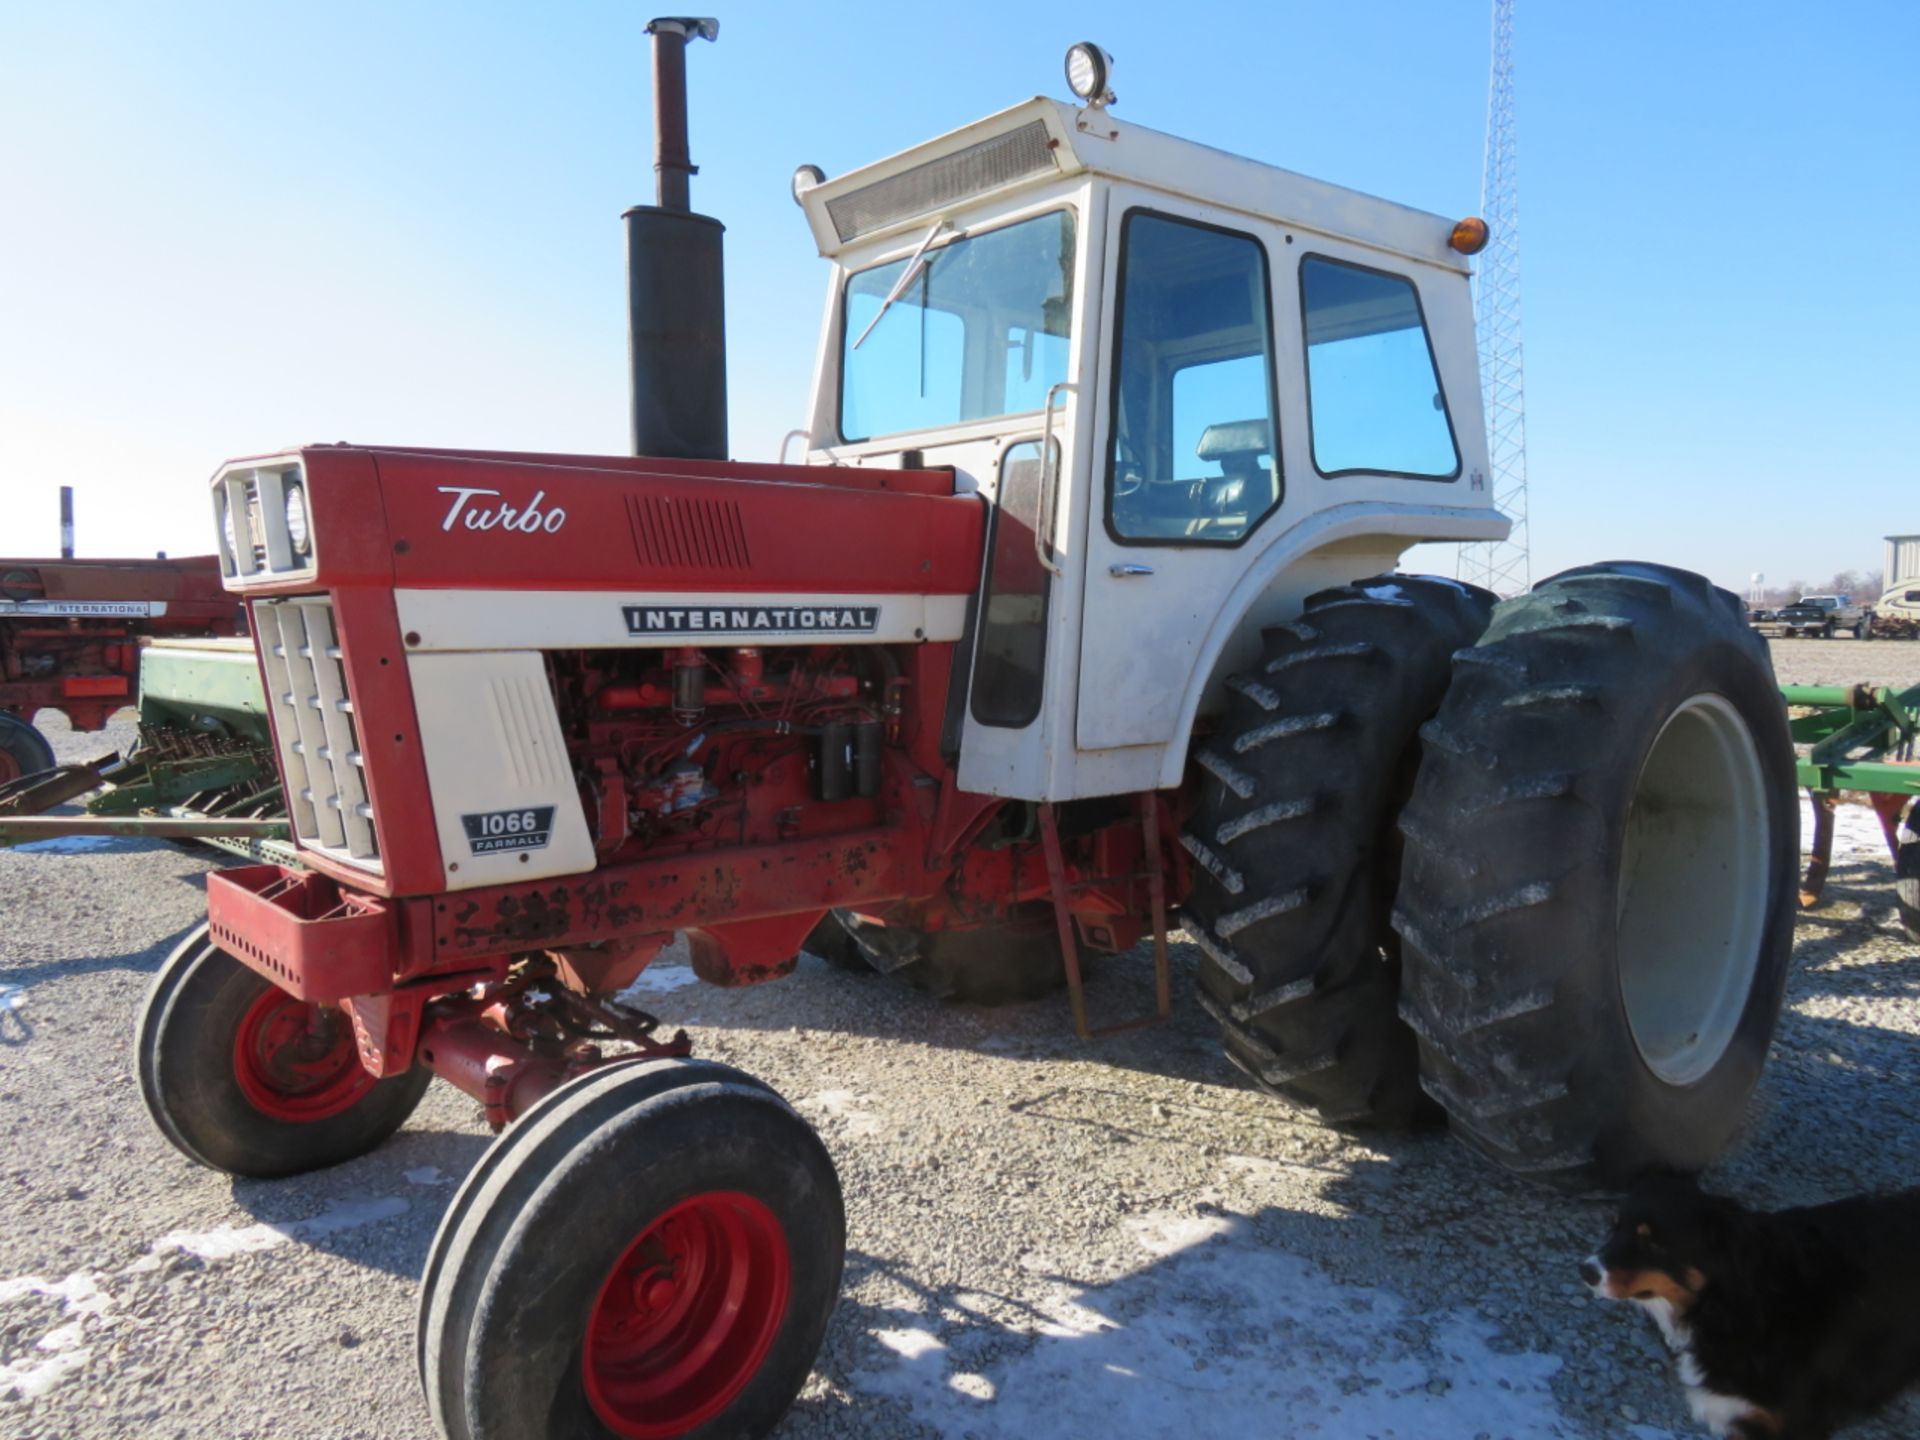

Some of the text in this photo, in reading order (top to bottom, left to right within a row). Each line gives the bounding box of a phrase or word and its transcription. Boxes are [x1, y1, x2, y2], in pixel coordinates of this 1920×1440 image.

[437, 486, 566, 533] Turbo
[54, 604, 148, 613] INTERNATIONAL
[632, 610, 872, 629] INTERNATIONAL
[480, 811, 536, 835] 1066
[476, 836, 543, 850] FARMALL
